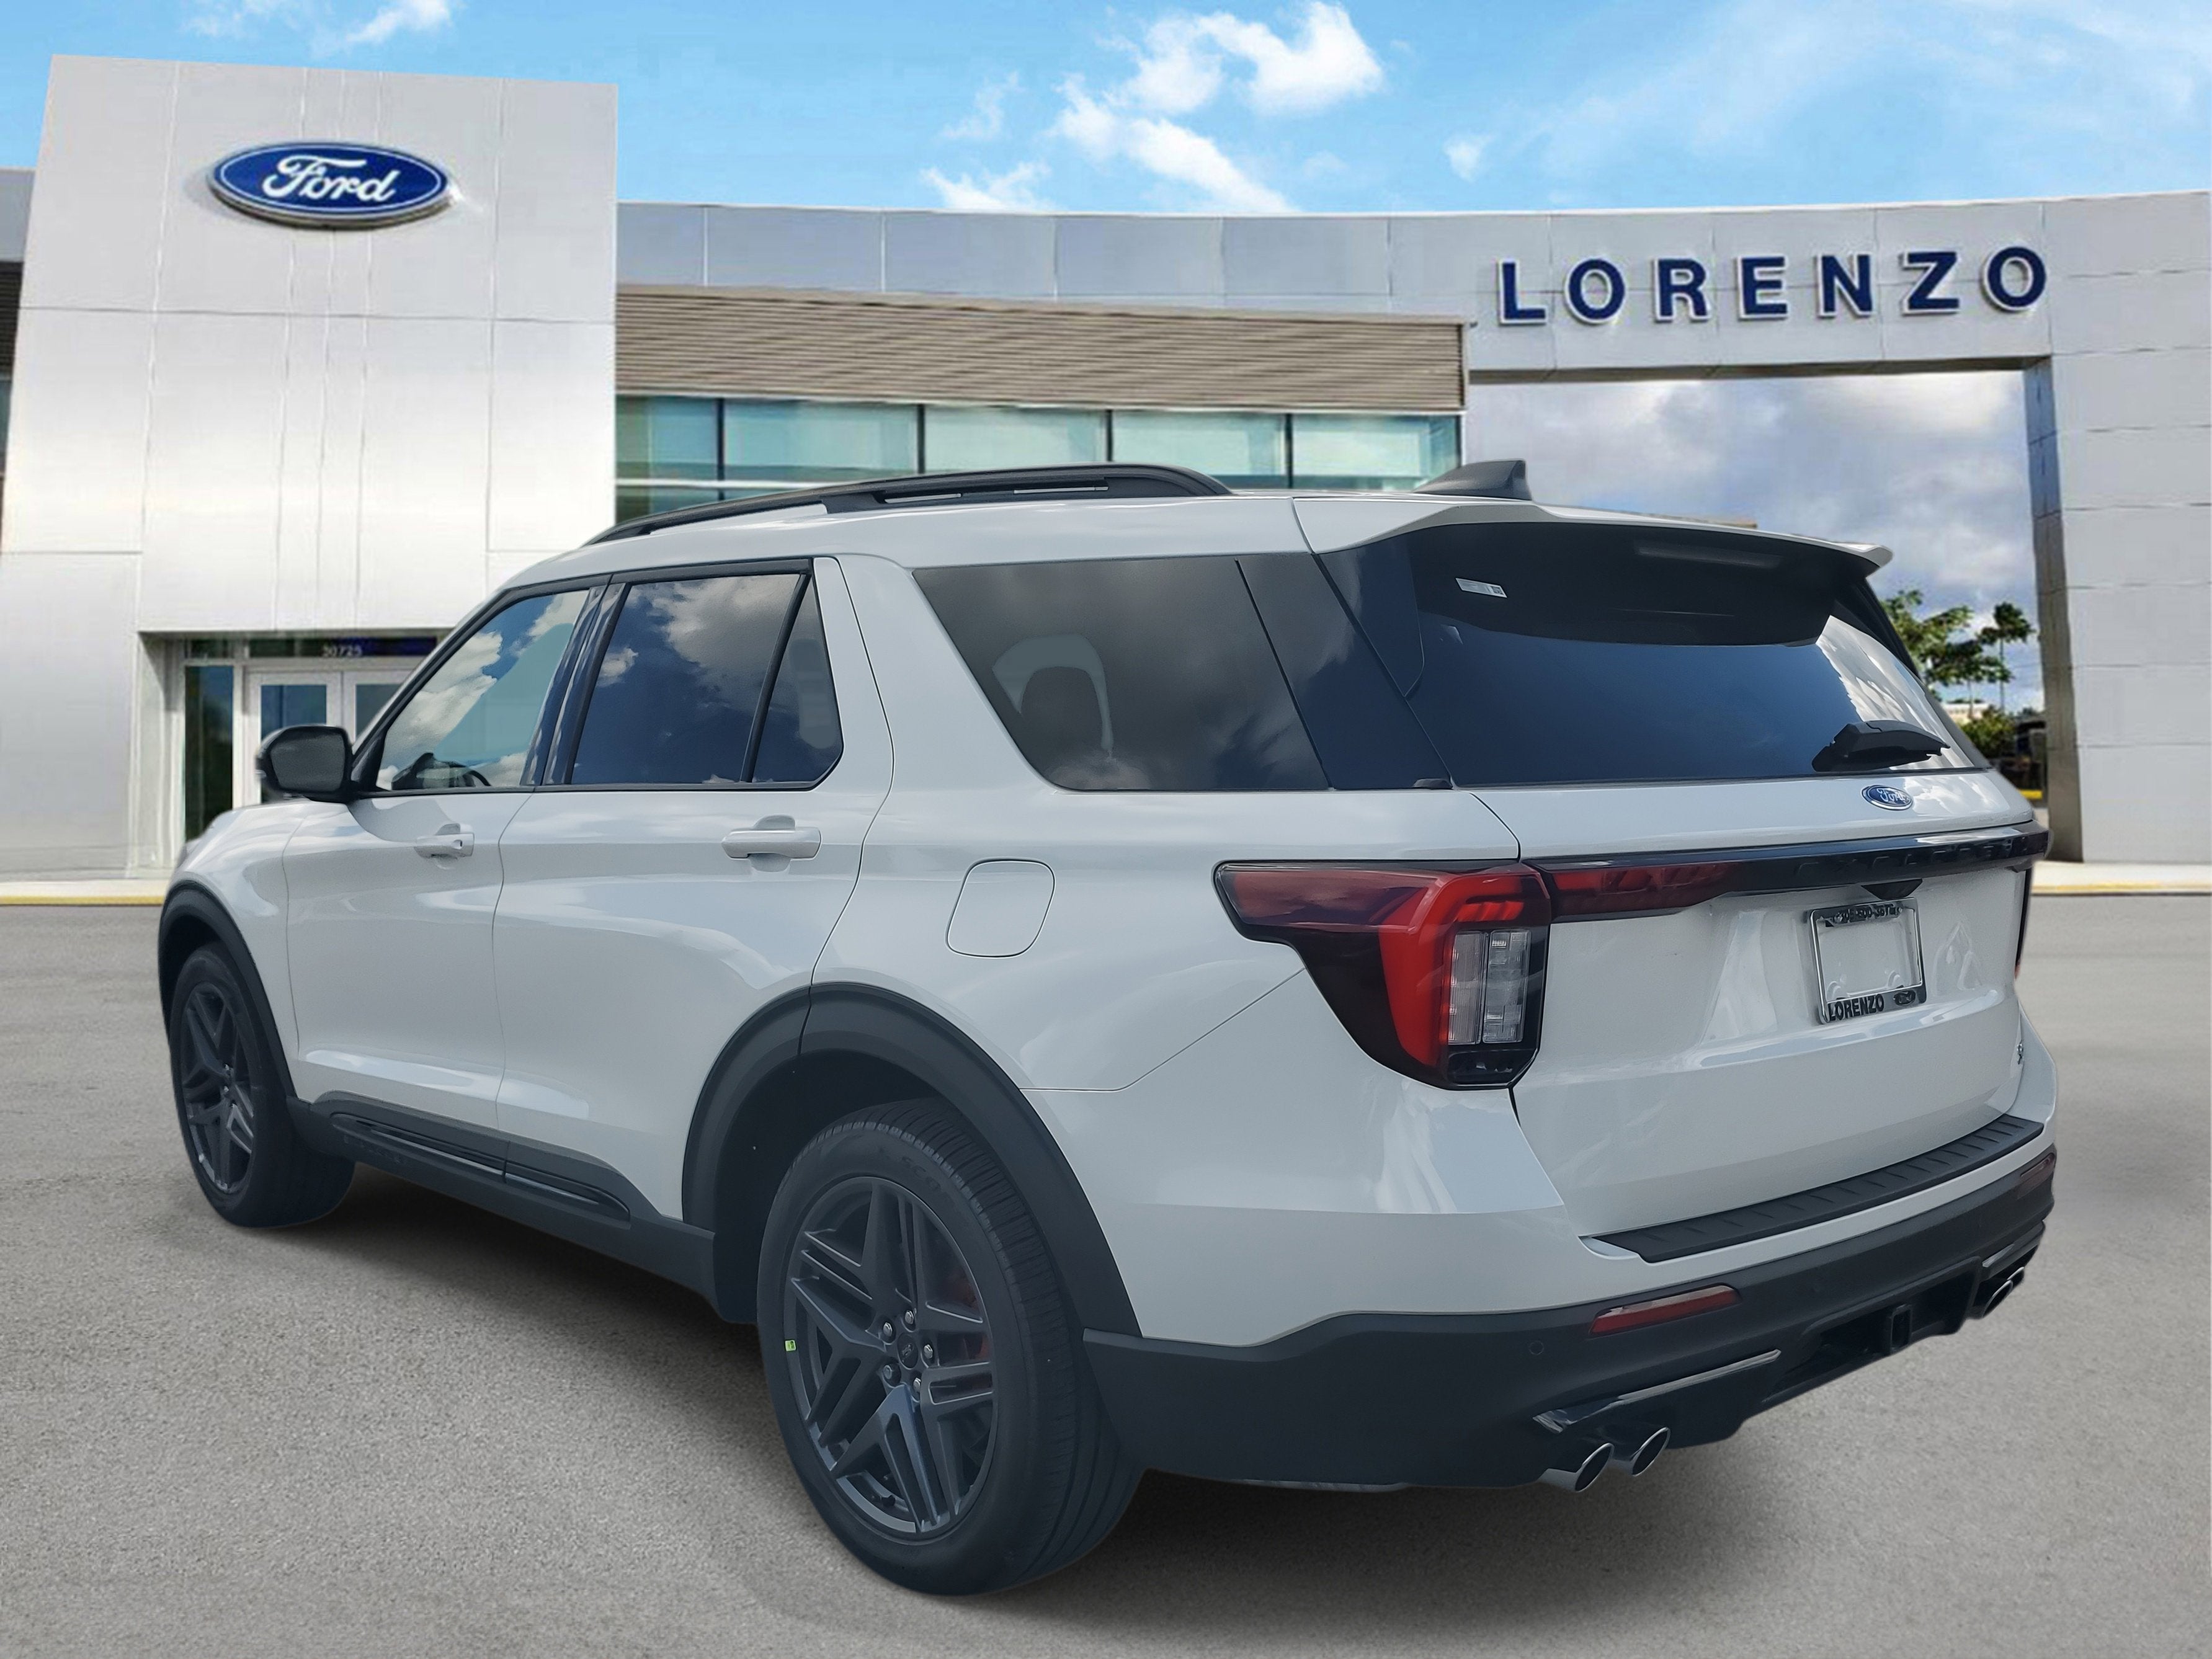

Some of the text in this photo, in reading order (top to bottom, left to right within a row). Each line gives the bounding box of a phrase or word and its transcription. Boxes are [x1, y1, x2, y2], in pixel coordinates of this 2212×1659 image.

[262, 154, 400, 202] Ford
[1497, 246, 2047, 326] LORENZO
[1827, 994, 1884, 1021] LORENZO
